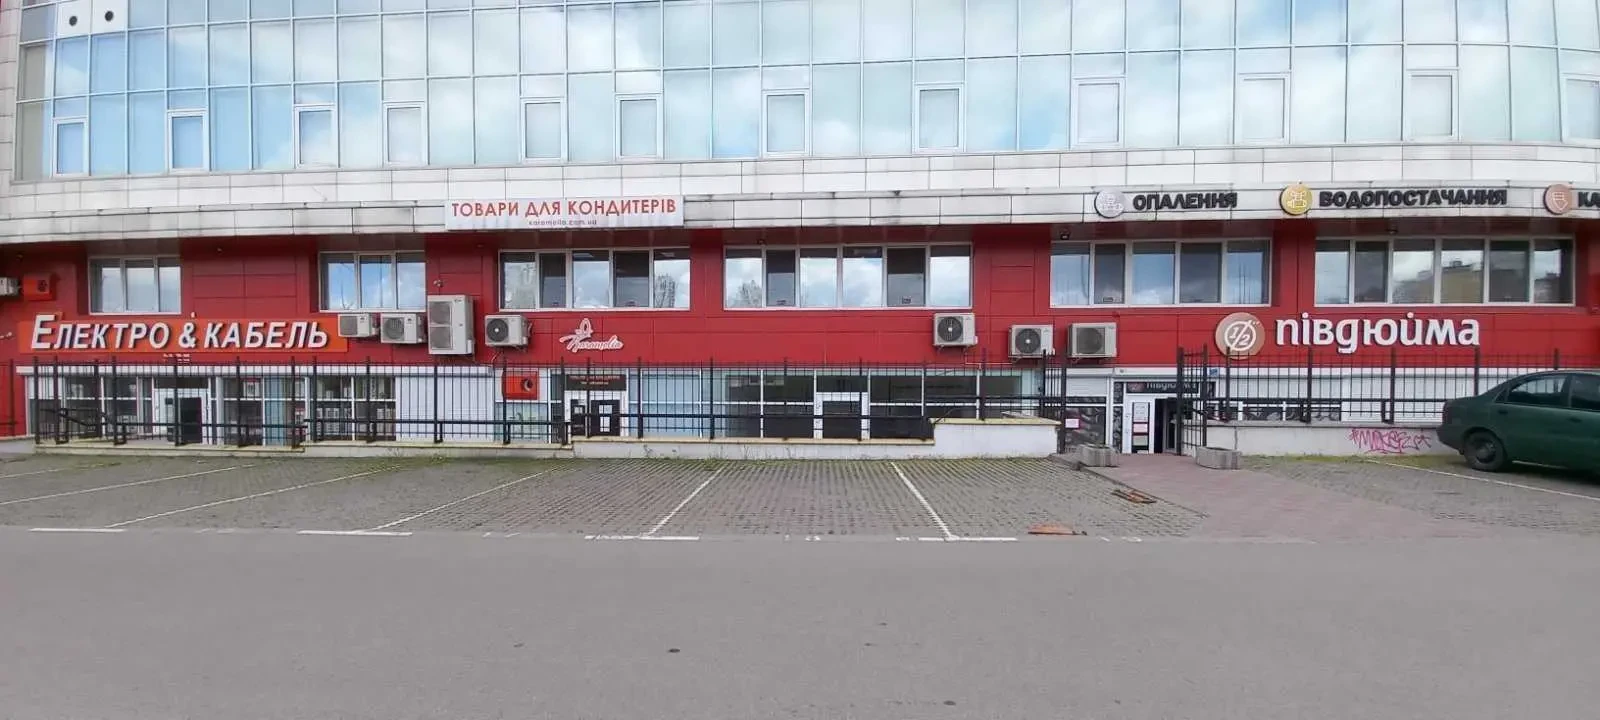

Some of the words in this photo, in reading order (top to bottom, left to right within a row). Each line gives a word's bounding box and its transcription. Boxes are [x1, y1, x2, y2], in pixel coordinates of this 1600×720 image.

[1132, 192, 1238, 211] ОПАЛЕННЯ
[1319, 189, 1508, 208] ВОДОПОСТАЧАННЯ
[451, 202, 518, 217] ТОВАРИ
[525, 202, 562, 218] ДЛЯ
[568, 199, 676, 216] КОНДИТЕРІВ
[178, 323, 197, 348] &
[203, 322, 329, 349] КАБЕЛЬ
